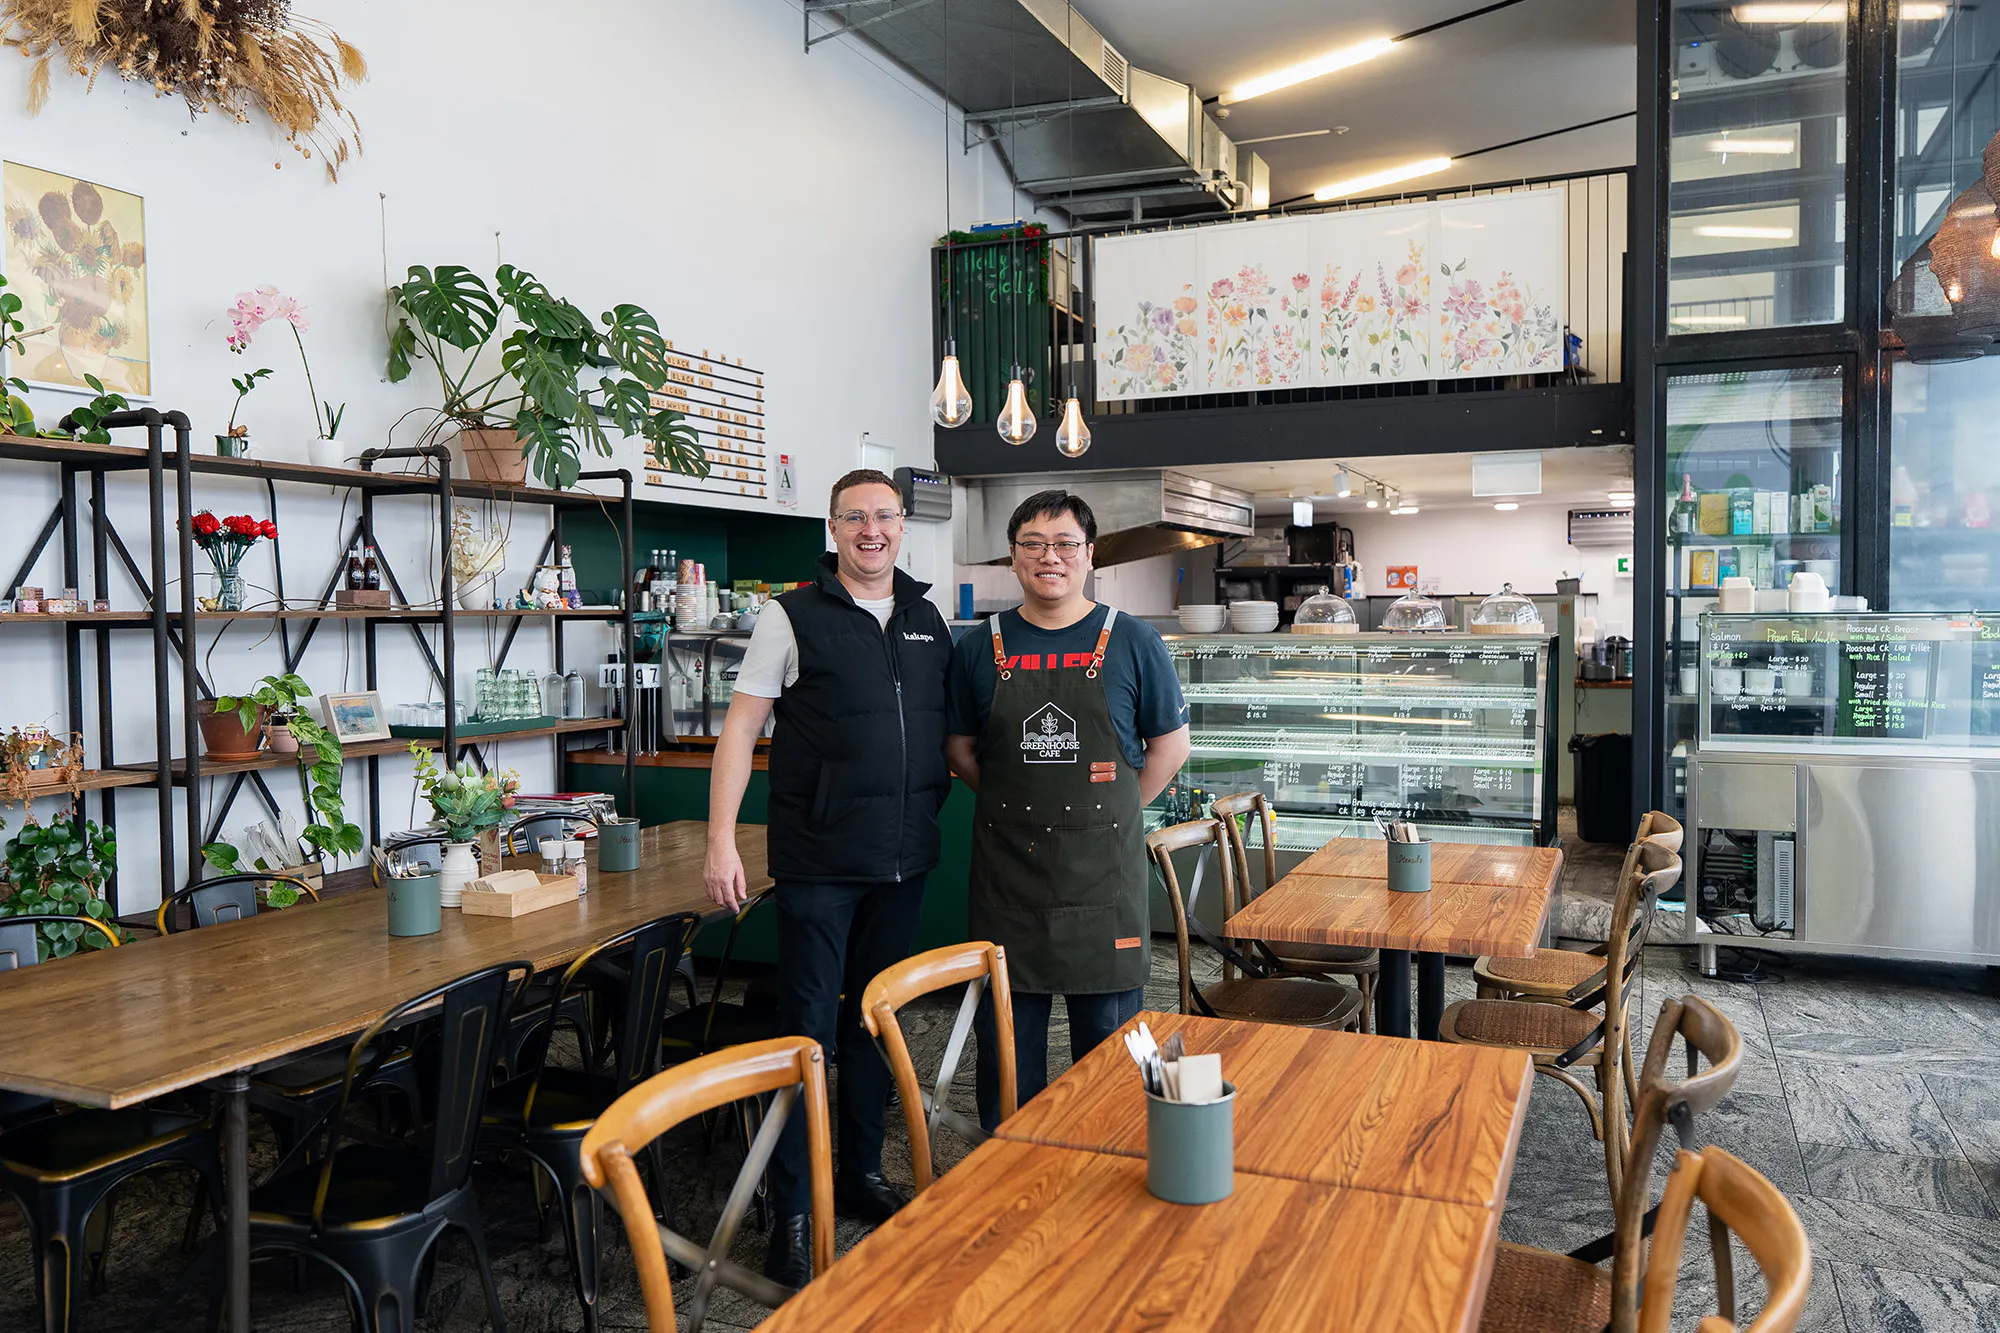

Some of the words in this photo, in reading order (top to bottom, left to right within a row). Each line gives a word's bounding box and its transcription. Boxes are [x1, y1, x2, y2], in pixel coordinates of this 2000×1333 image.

[667, 357, 690, 368] BLACK
[672, 373, 694, 384] BLACK
[651, 399, 665, 407] LAT
[667, 401, 690, 412] WHITE
[781, 468, 791, 489] A
[1846, 624, 1877, 634] Roasted
[1894, 624, 1920, 634] Breast
[902, 632, 934, 642] kakapo
[1710, 631, 1741, 641] Salmon
[1865, 633, 1880, 641] Rice
[1886, 633, 1907, 641] Salad
[1845, 643, 1876, 653] Roasted
[1894, 643, 1907, 653] Leg
[1910, 643, 1932, 653] Fillet
[1769, 656, 1789, 664] Large
[1866, 653, 1881, 661] Rice
[1887, 653, 1911, 662] Salad
[604, 668, 617, 684] 10
[635, 669, 643, 685] 9
[649, 668, 658, 683] 7
[1856, 672, 1877, 682] Large
[1855, 691, 1874, 699] Small
[1882, 699, 1906, 707] Noodles
[1930, 701, 1946, 710] Rice
[1855, 705, 1874, 714] Large
[1020, 741, 1080, 750] GREENHOUSE
[1039, 750, 1061, 758] CAFE
[1264, 762, 1282, 770] Large
[1328, 764, 1344, 772] Large
[1402, 765, 1420, 774] Large
[1474, 767, 1490, 777] Large
[1401, 780, 1419, 788] Small
[1473, 782, 1490, 790] Small
[1352, 799, 1376, 807] Breast
[1380, 800, 1402, 809] Combo
[1353, 808, 1366, 817] Leg
[1371, 808, 1392, 817] Combo
